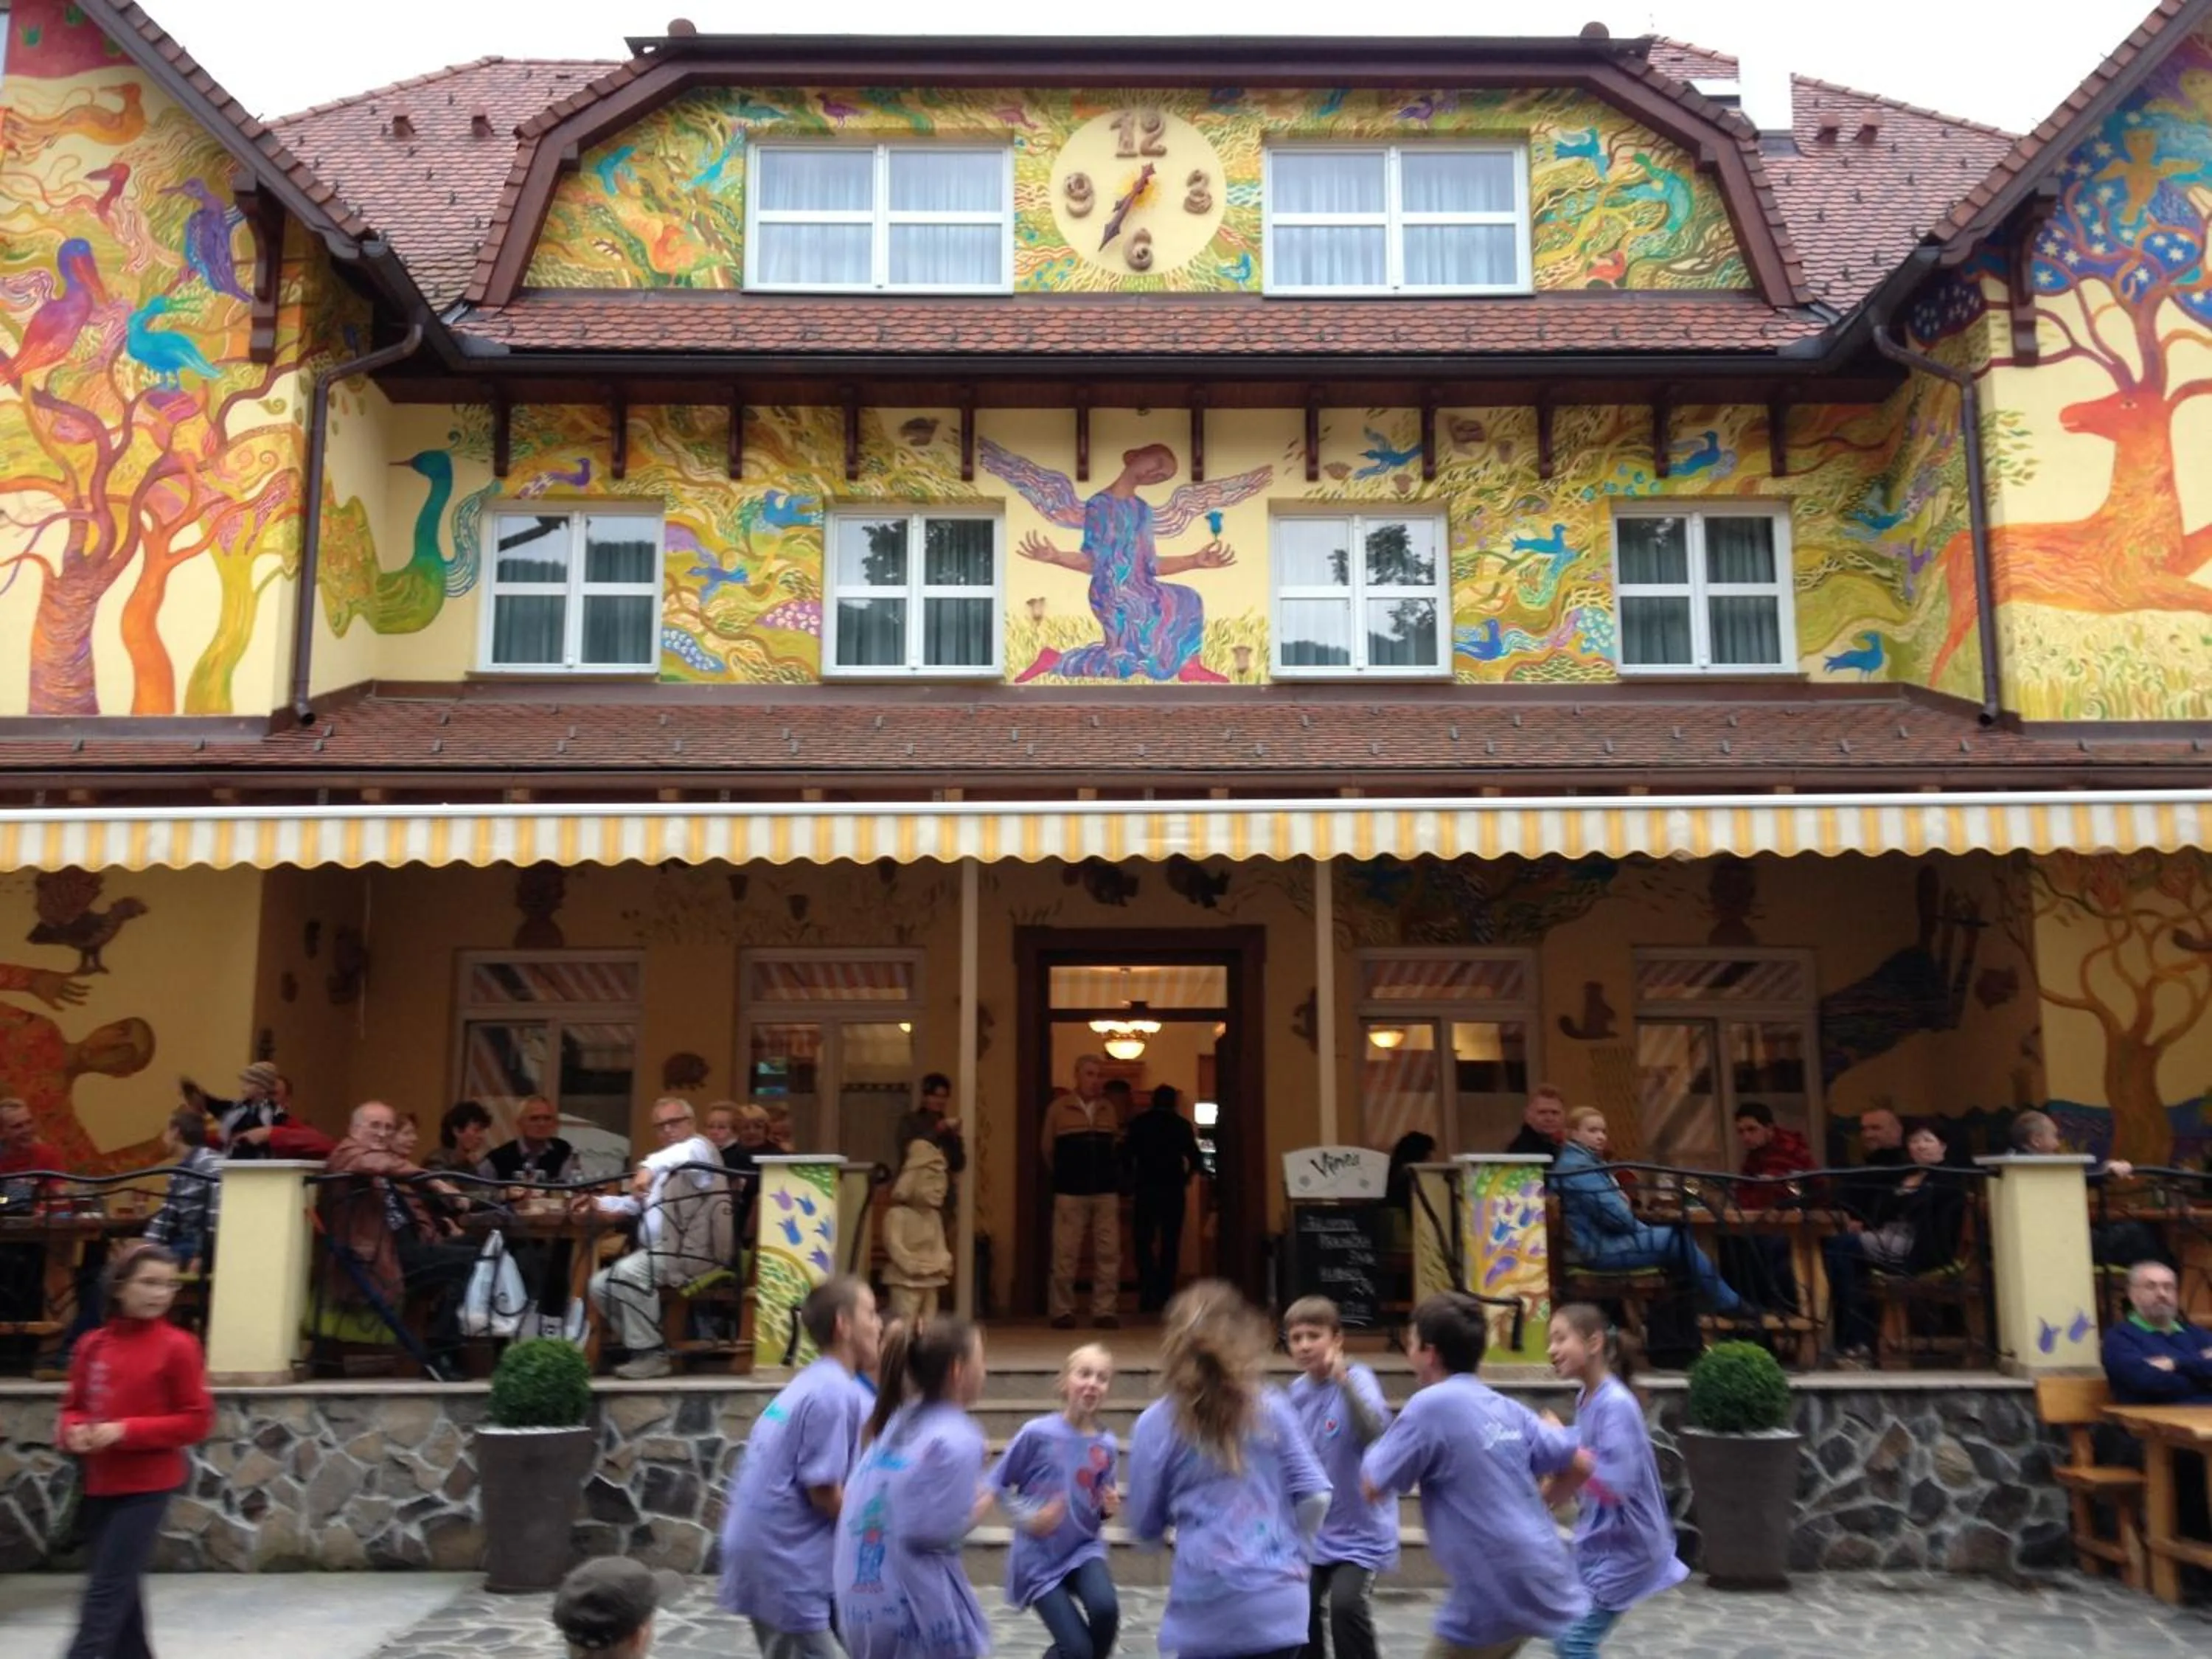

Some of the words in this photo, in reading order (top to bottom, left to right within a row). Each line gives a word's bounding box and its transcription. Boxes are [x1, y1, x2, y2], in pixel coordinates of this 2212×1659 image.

[1110, 110, 1167, 158] 12
[1063, 172, 1095, 219] 9
[1183, 169, 1213, 215] 3
[1123, 228, 1153, 271] 6
